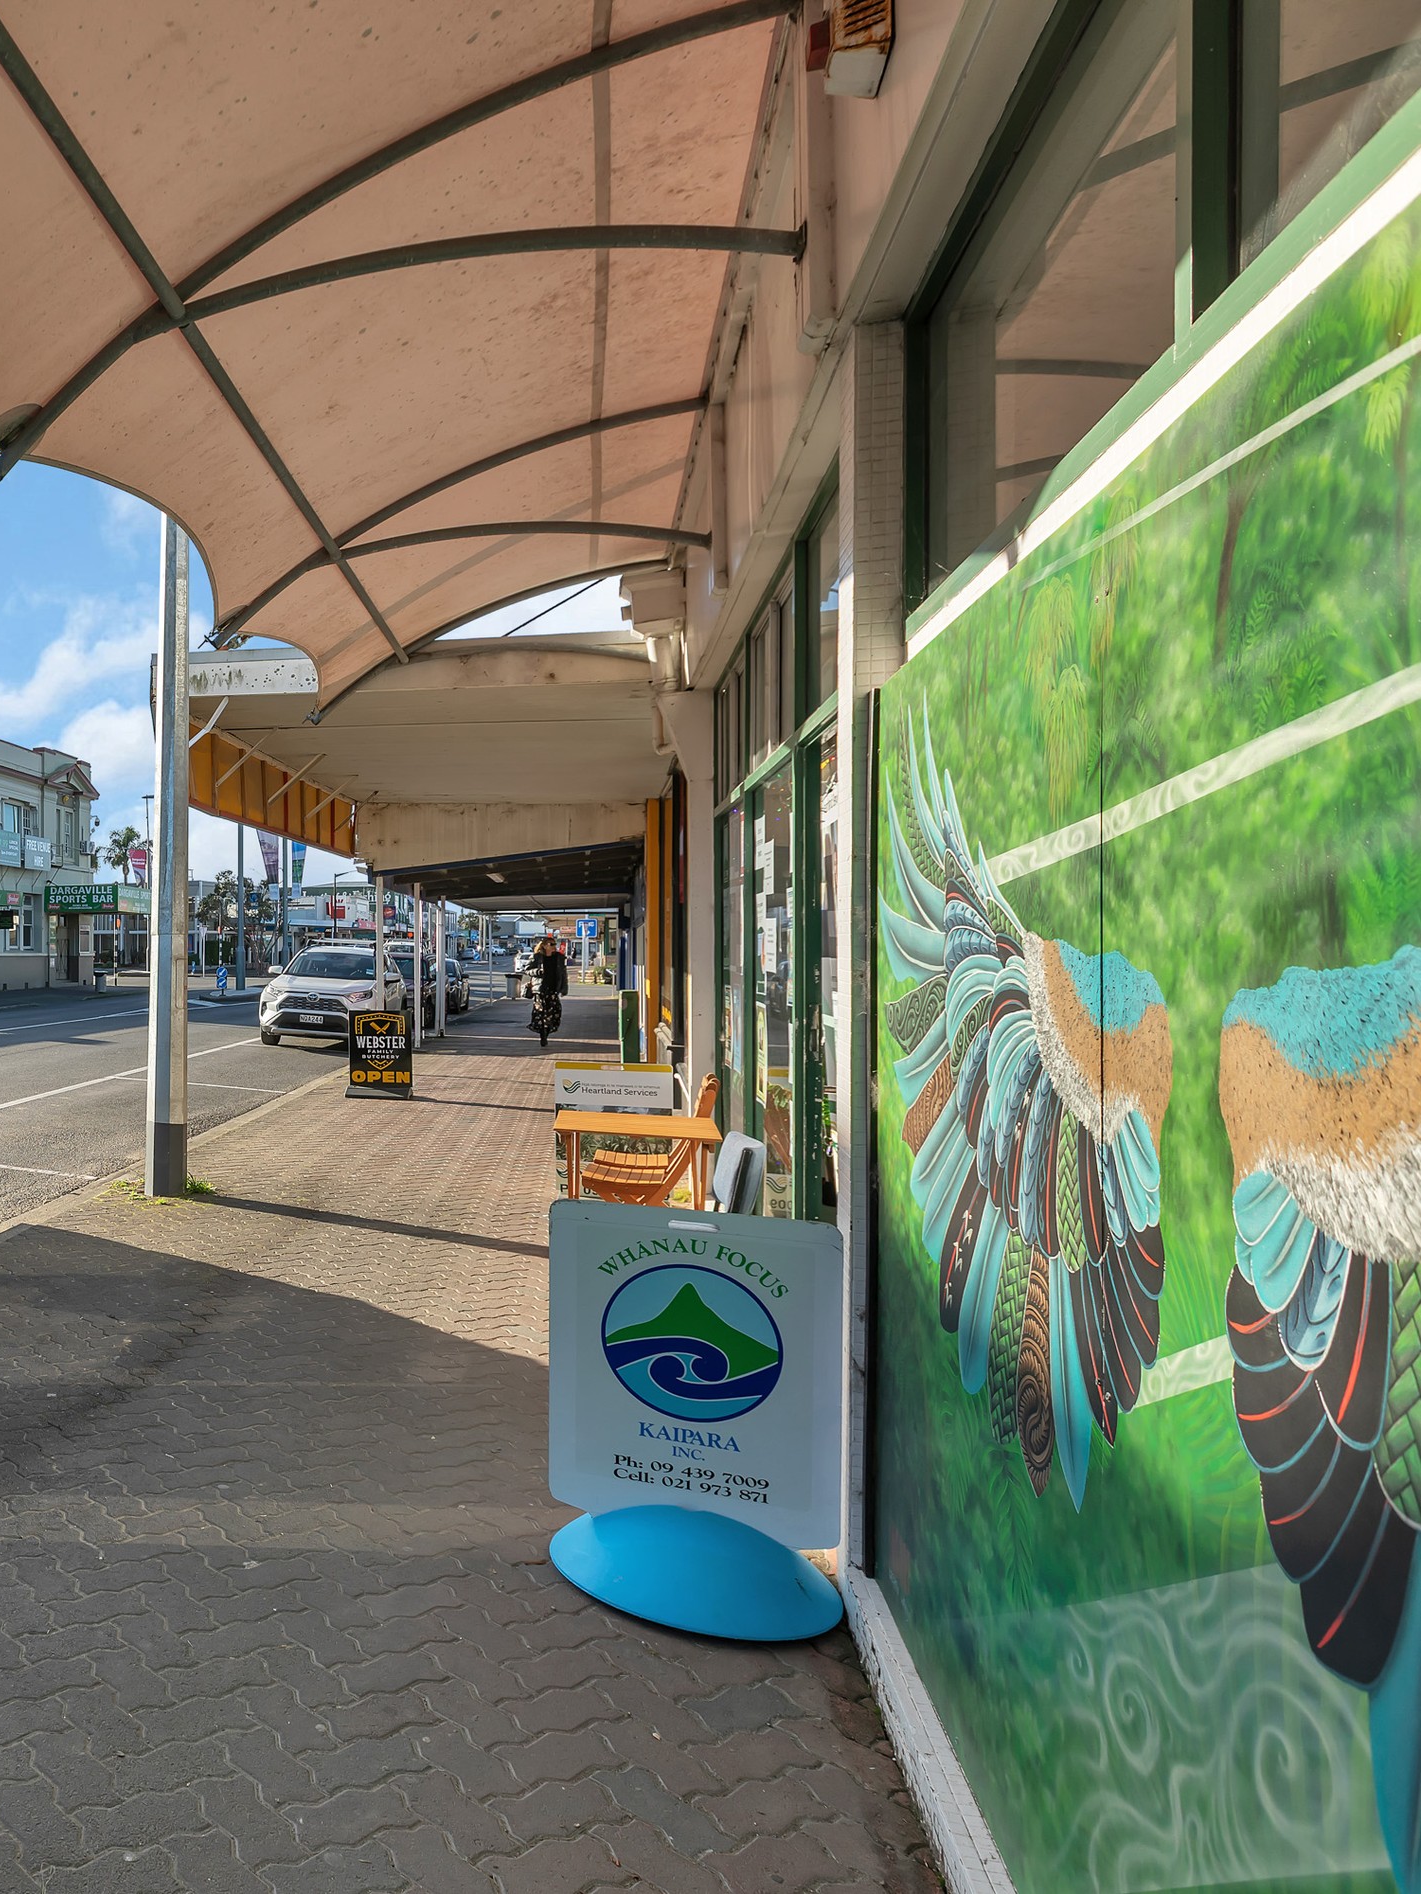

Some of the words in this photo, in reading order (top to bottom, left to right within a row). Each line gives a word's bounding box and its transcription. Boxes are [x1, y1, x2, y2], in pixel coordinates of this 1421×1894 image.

[26, 839, 37, 851] FREE
[50, 886, 112, 895] DARGAVILLE
[49, 895, 87, 904] SPORTS
[92, 895, 113, 903] BAR
[356, 1035, 406, 1049] WEBSTER
[351, 1070, 410, 1083] OPEN
[581, 1086, 622, 1095] Heartland
[623, 1088, 658, 1097] Services
[597, 1238, 708, 1277] WHĀNAU
[715, 1244, 789, 1299] FOCUS
[638, 1421, 741, 1453] KAIPARA
[672, 1446, 705, 1461] INC.
[613, 1454, 643, 1468] Ph:
[650, 1461, 674, 1474] 09
[681, 1467, 715, 1480] 439
[722, 1472, 770, 1490] 7009
[613, 1467, 655, 1484] Cell:
[662, 1476, 692, 1491] 021
[699, 1482, 731, 1497] 973
[739, 1489, 769, 1504] 871
